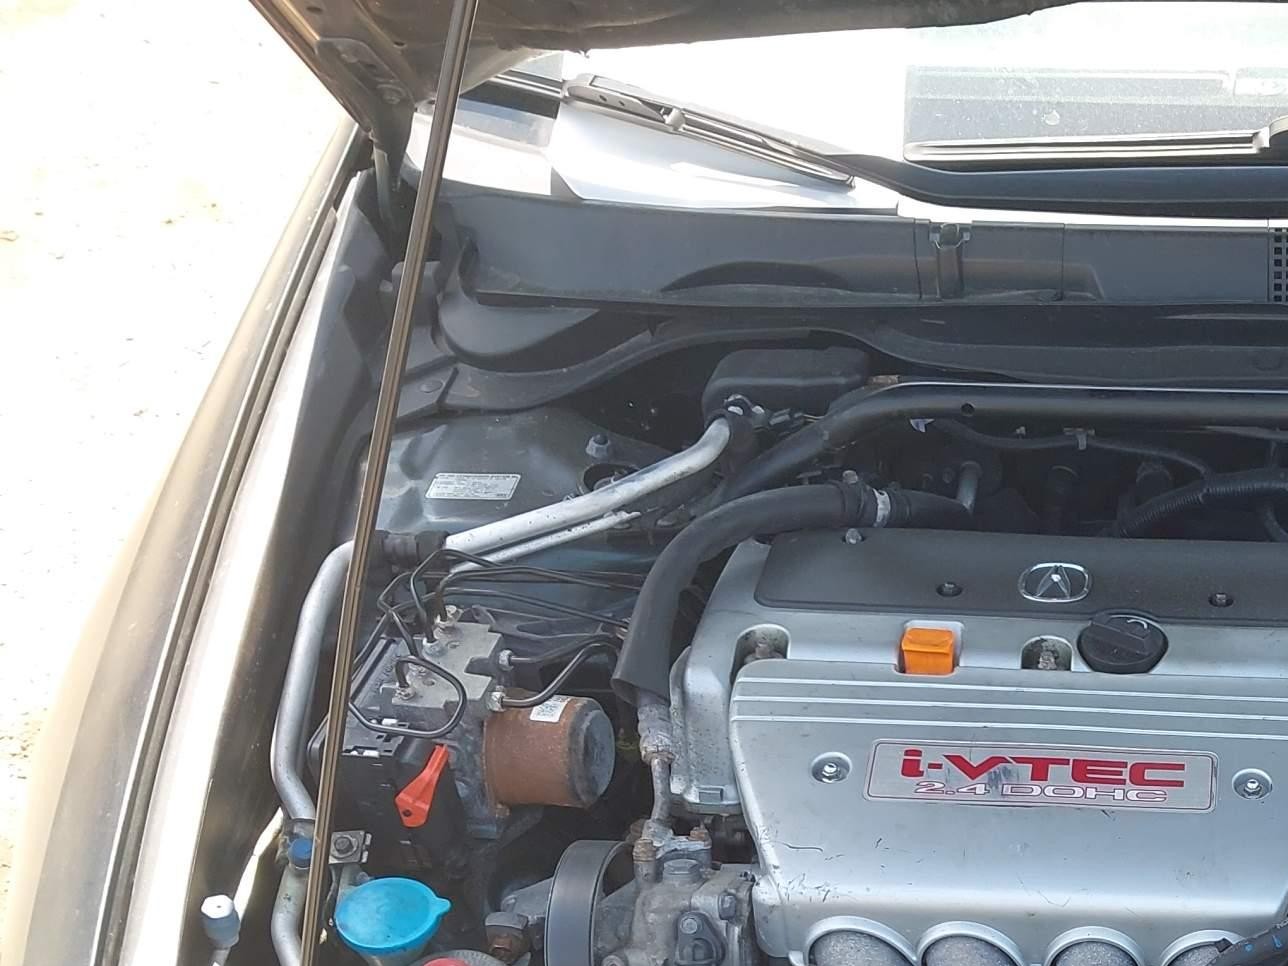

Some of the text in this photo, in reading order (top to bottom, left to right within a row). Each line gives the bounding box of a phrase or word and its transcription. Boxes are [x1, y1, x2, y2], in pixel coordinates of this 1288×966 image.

[901, 748, 1185, 788] i-VTEC
[914, 781, 1168, 802] 2.4 DOHC
